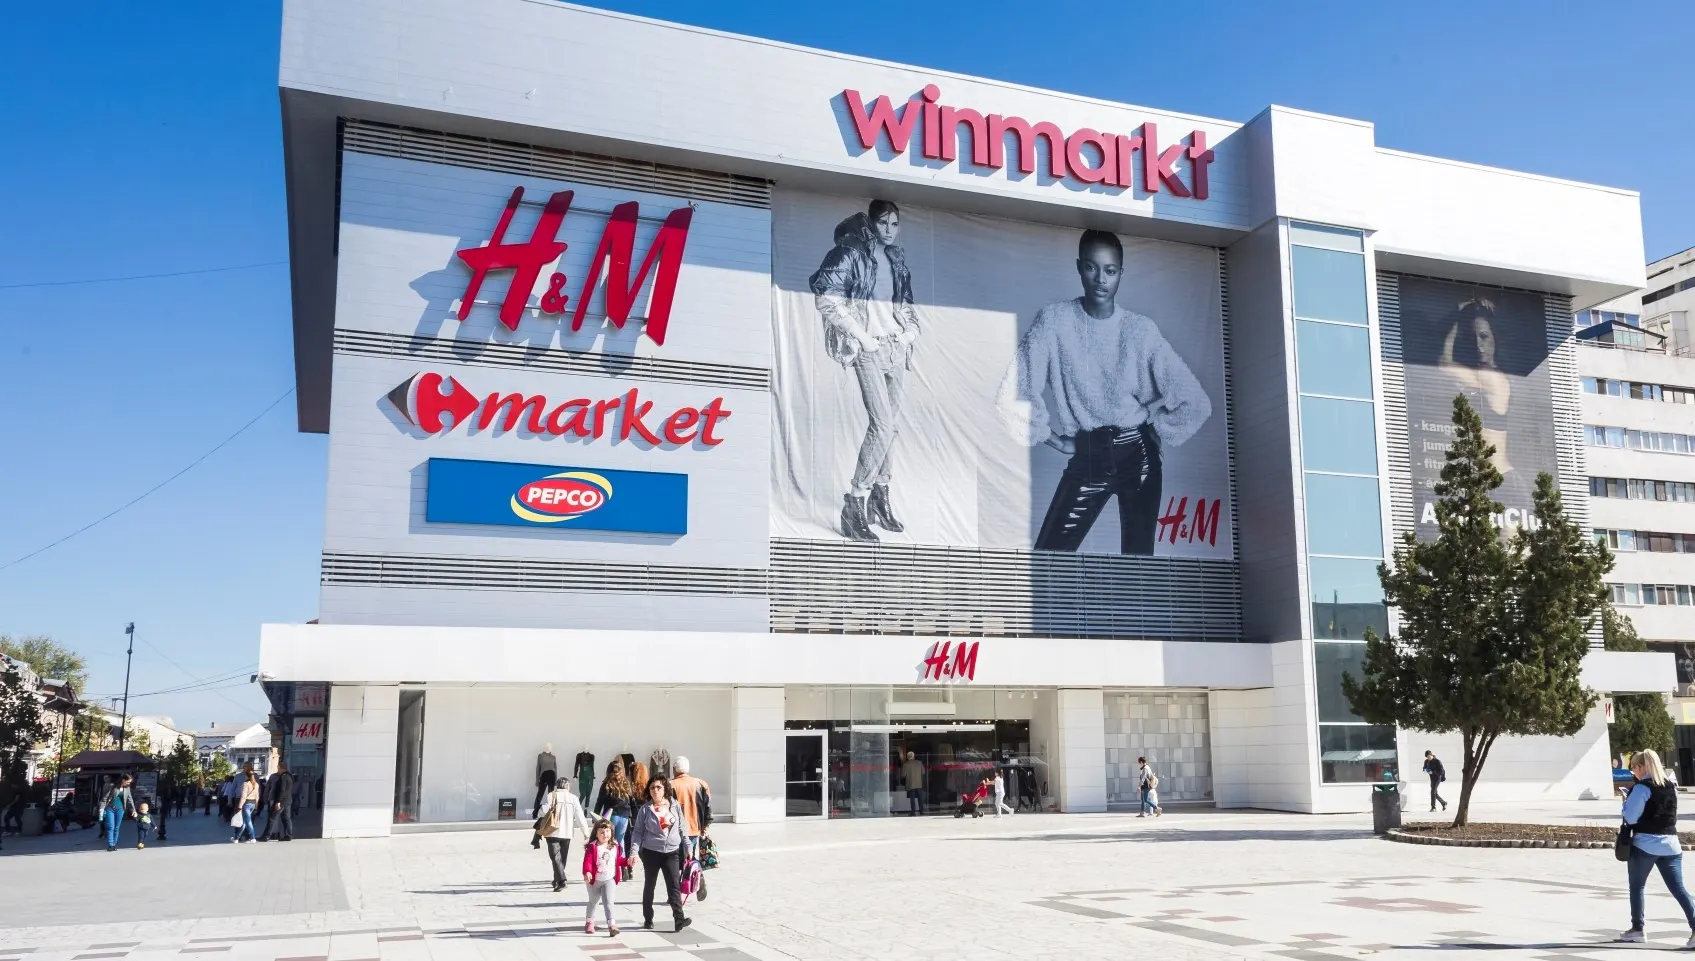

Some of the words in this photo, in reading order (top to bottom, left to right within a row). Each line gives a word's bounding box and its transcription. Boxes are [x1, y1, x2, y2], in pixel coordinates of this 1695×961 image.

[843, 83, 1214, 200] winmarkt
[456, 185, 693, 347] H&M
[478, 387, 732, 447] market
[527, 486, 598, 507] PEPCO
[1156, 496, 1221, 547] H&M
[924, 641, 980, 681] H&M
[295, 722, 322, 738] H&M
